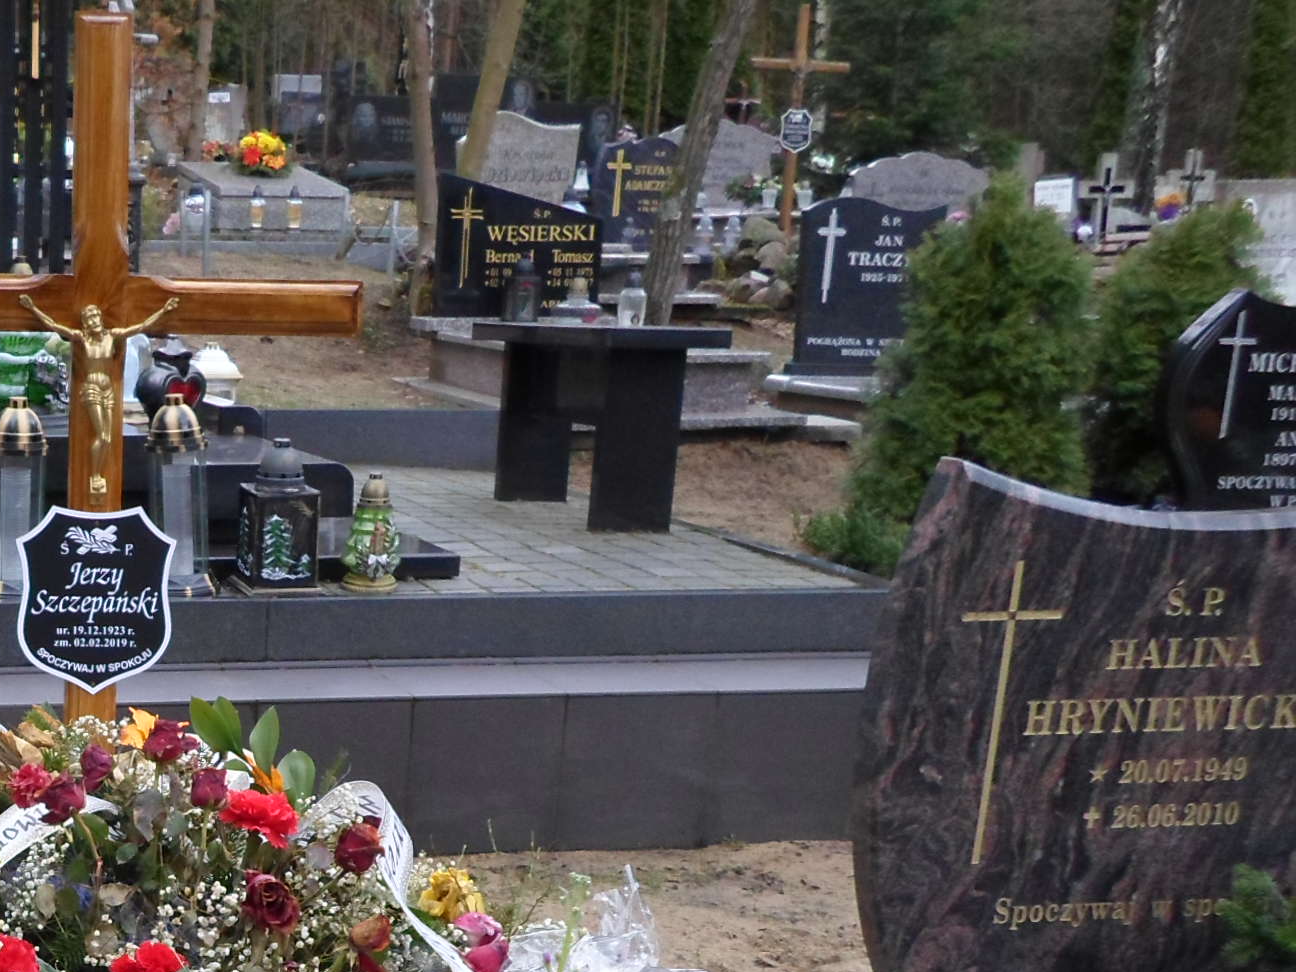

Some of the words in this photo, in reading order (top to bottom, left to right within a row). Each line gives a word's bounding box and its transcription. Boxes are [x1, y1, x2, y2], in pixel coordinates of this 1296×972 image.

[487, 224, 596, 245] WĘSIERSKI
[874, 235, 904, 247] JAN
[552, 249, 593, 263] Tomasz
[65, 562, 124, 595] Jerzy
[31, 587, 159, 624] Szczepański
[54, 639, 71, 648] zm.
[74, 638, 128, 648] 02.02.2019
[56, 626, 70, 635] ur.
[73, 625, 125, 636] 19.12.1923
[36, 647, 94, 673] SPOCZYWAJ
[96, 664, 106, 673] W
[108, 648, 153, 672] SPOKOJU
[1105, 636, 1262, 670] HALINA
[1117, 757, 1248, 785] 20.07.1949
[1110, 802, 1239, 830] 26.06.2010
[1183, 898, 1229, 923] spo
